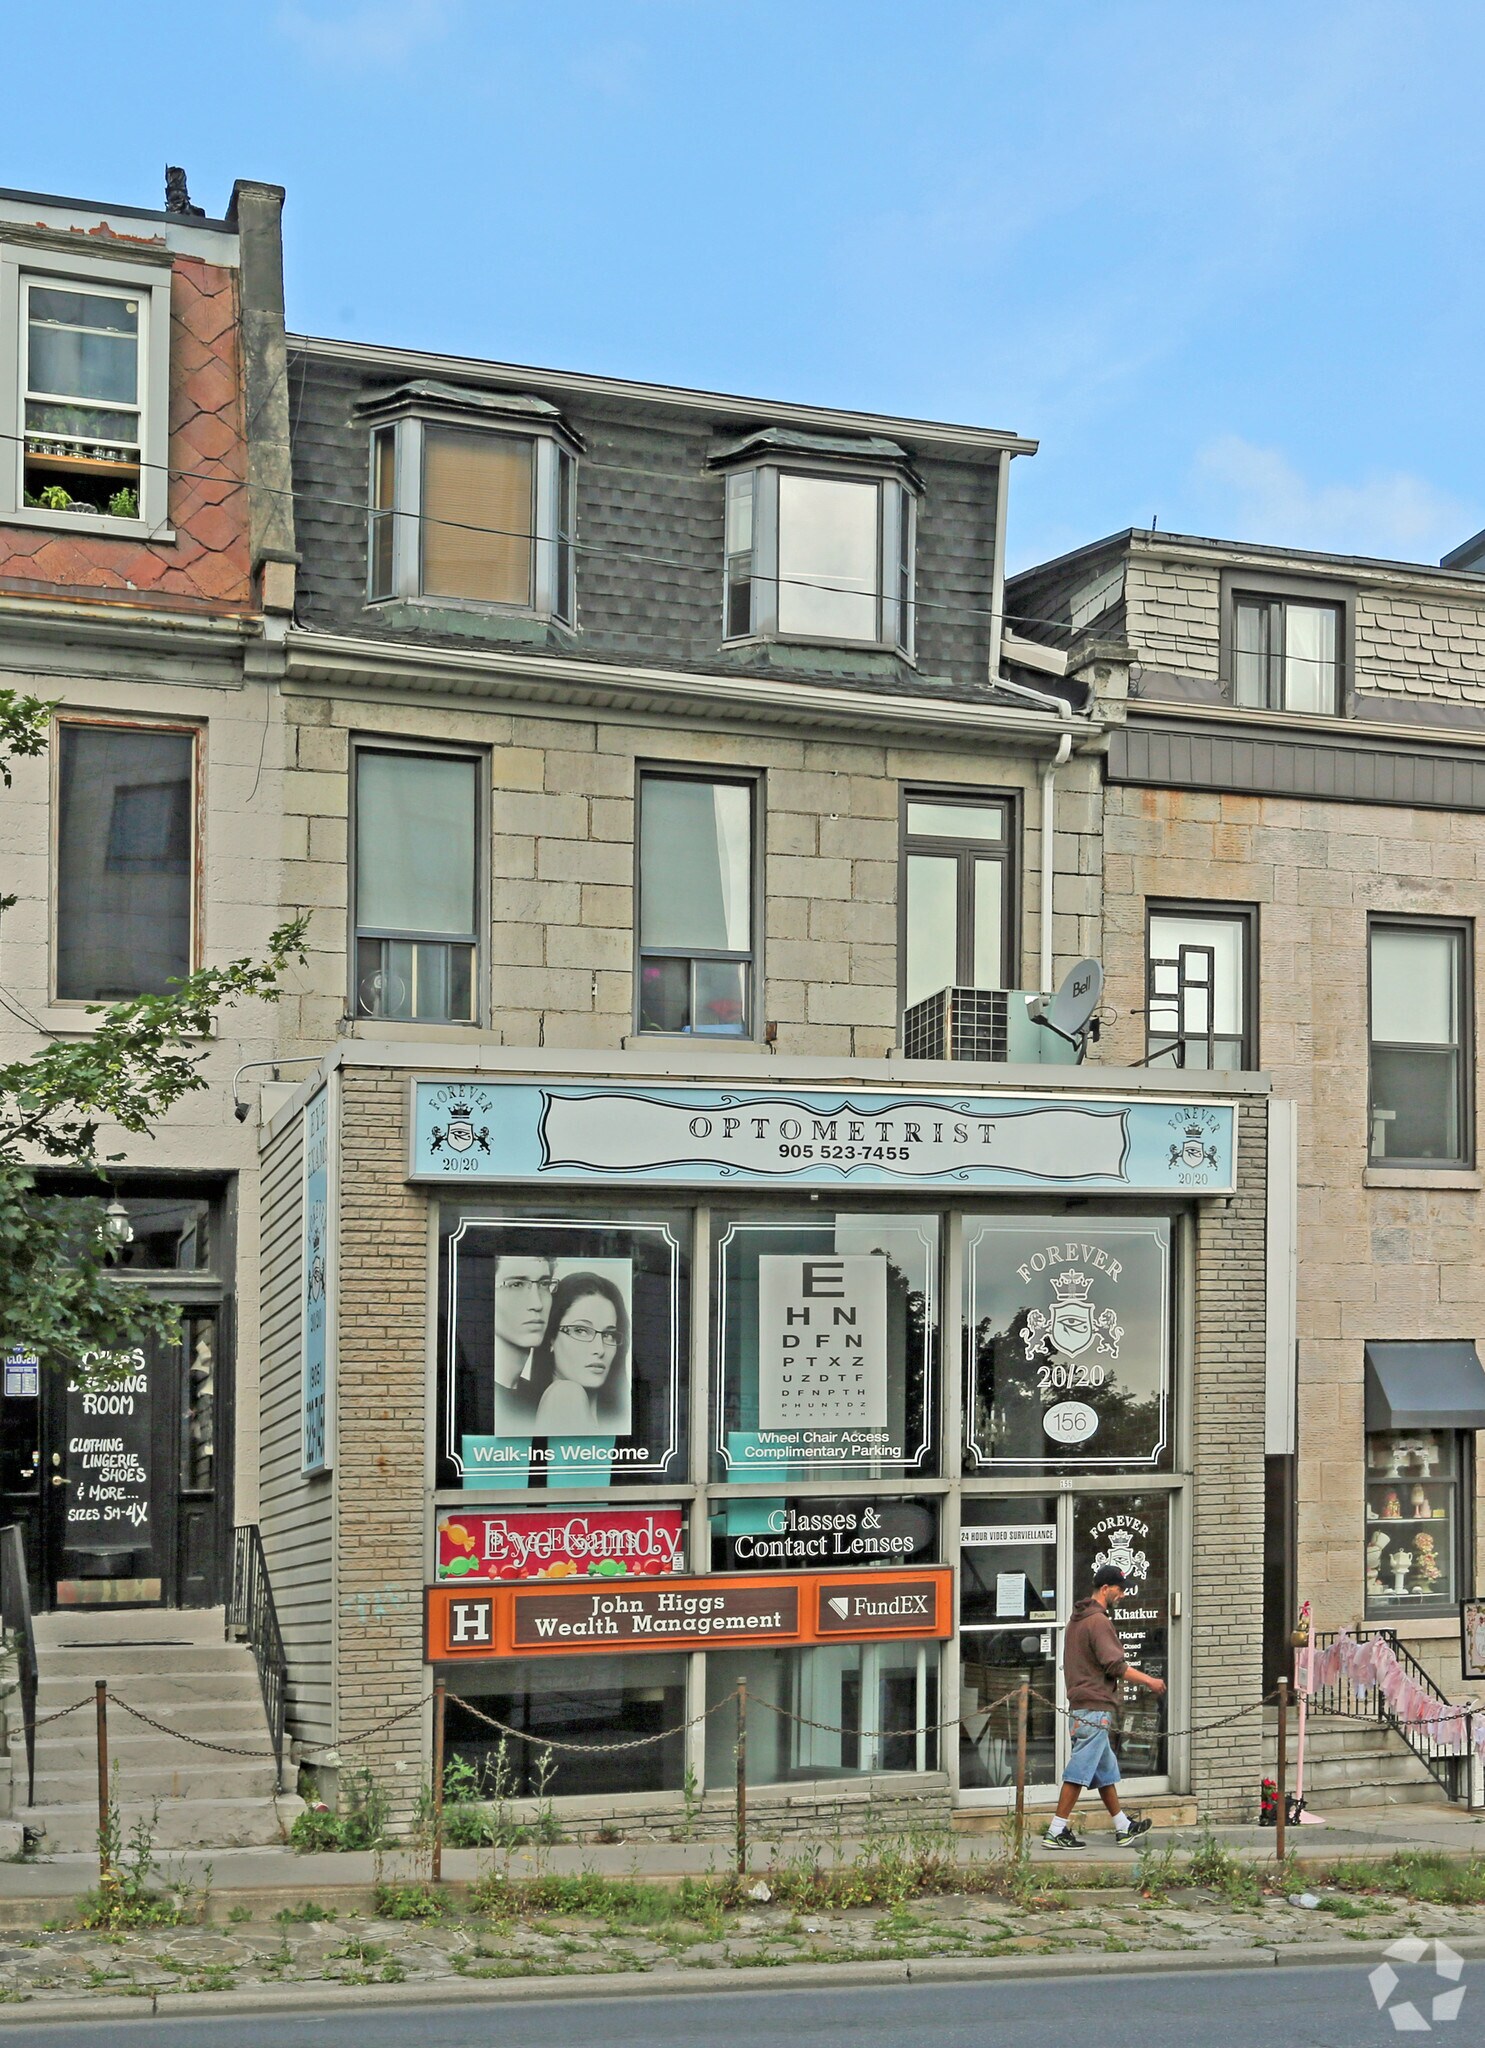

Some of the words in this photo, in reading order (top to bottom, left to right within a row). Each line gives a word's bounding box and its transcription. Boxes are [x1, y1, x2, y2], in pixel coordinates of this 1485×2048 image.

[1073, 975, 1091, 998] Bell
[429, 1083, 493, 1114] FOREVER
[310, 1098, 326, 1138] EYE
[1168, 1106, 1221, 1134] FOREVER
[688, 1117, 996, 1144] OPTOMETRIST
[779, 1144, 814, 1159] 905
[820, 1145, 910, 1160] 523-7455
[443, 1157, 479, 1173] 20/20
[1178, 1172, 1209, 1187] 20/20
[1016, 1242, 1123, 1284] FOREVER
[802, 1262, 845, 1298] E
[787, 1307, 810, 1325] H
[833, 1306, 856, 1325] N
[783, 1335, 800, 1348] D
[816, 1334, 830, 1348] F
[846, 1334, 862, 1347] N
[783, 1357, 795, 1367] P
[806, 1357, 817, 1366] T
[828, 1357, 841, 1366] X
[852, 1357, 864, 1366] Z
[838, 1374, 847, 1382] T
[1036, 1364, 1105, 1389] 20/20
[82, 1393, 134, 1415] ROOM
[1053, 1411, 1087, 1431] 156
[69, 1437, 124, 1452] CLOTHING
[758, 1432, 801, 1443] Wheel
[803, 1431, 838, 1443] Chair
[841, 1431, 889, 1443] Access
[82, 1454, 139, 1469] LINGERIE
[473, 1446, 556, 1462] Walk-Ins
[560, 1445, 649, 1461] Welcome
[744, 1446, 847, 1460] Complimentary
[851, 1446, 901, 1458] Parking
[99, 1467, 147, 1482] SHOES
[76, 1482, 85, 1500] &
[1060, 1479, 1072, 1489] 156
[67, 1508, 101, 1521] SIZES
[767, 1510, 856, 1533] Glasses
[861, 1507, 881, 1529] &
[961, 1532, 969, 1541] 24
[971, 1531, 988, 1541] HOUR
[989, 1531, 1007, 1541] VIDEO
[1009, 1530, 1053, 1540] SURVIELLANCE
[1089, 1515, 1149, 1539] FOREVER
[734, 1536, 827, 1558] Contact
[833, 1532, 914, 1555] Lenses
[592, 1596, 643, 1616] John
[658, 1594, 725, 1614] Higgs
[854, 1594, 928, 1616] FundEX
[1114, 1608, 1158, 1620] Khatkur
[453, 1604, 489, 1642] H
[535, 1617, 618, 1636] Wealth
[632, 1610, 781, 1635] Management
[1119, 1631, 1146, 1640] Hours:
